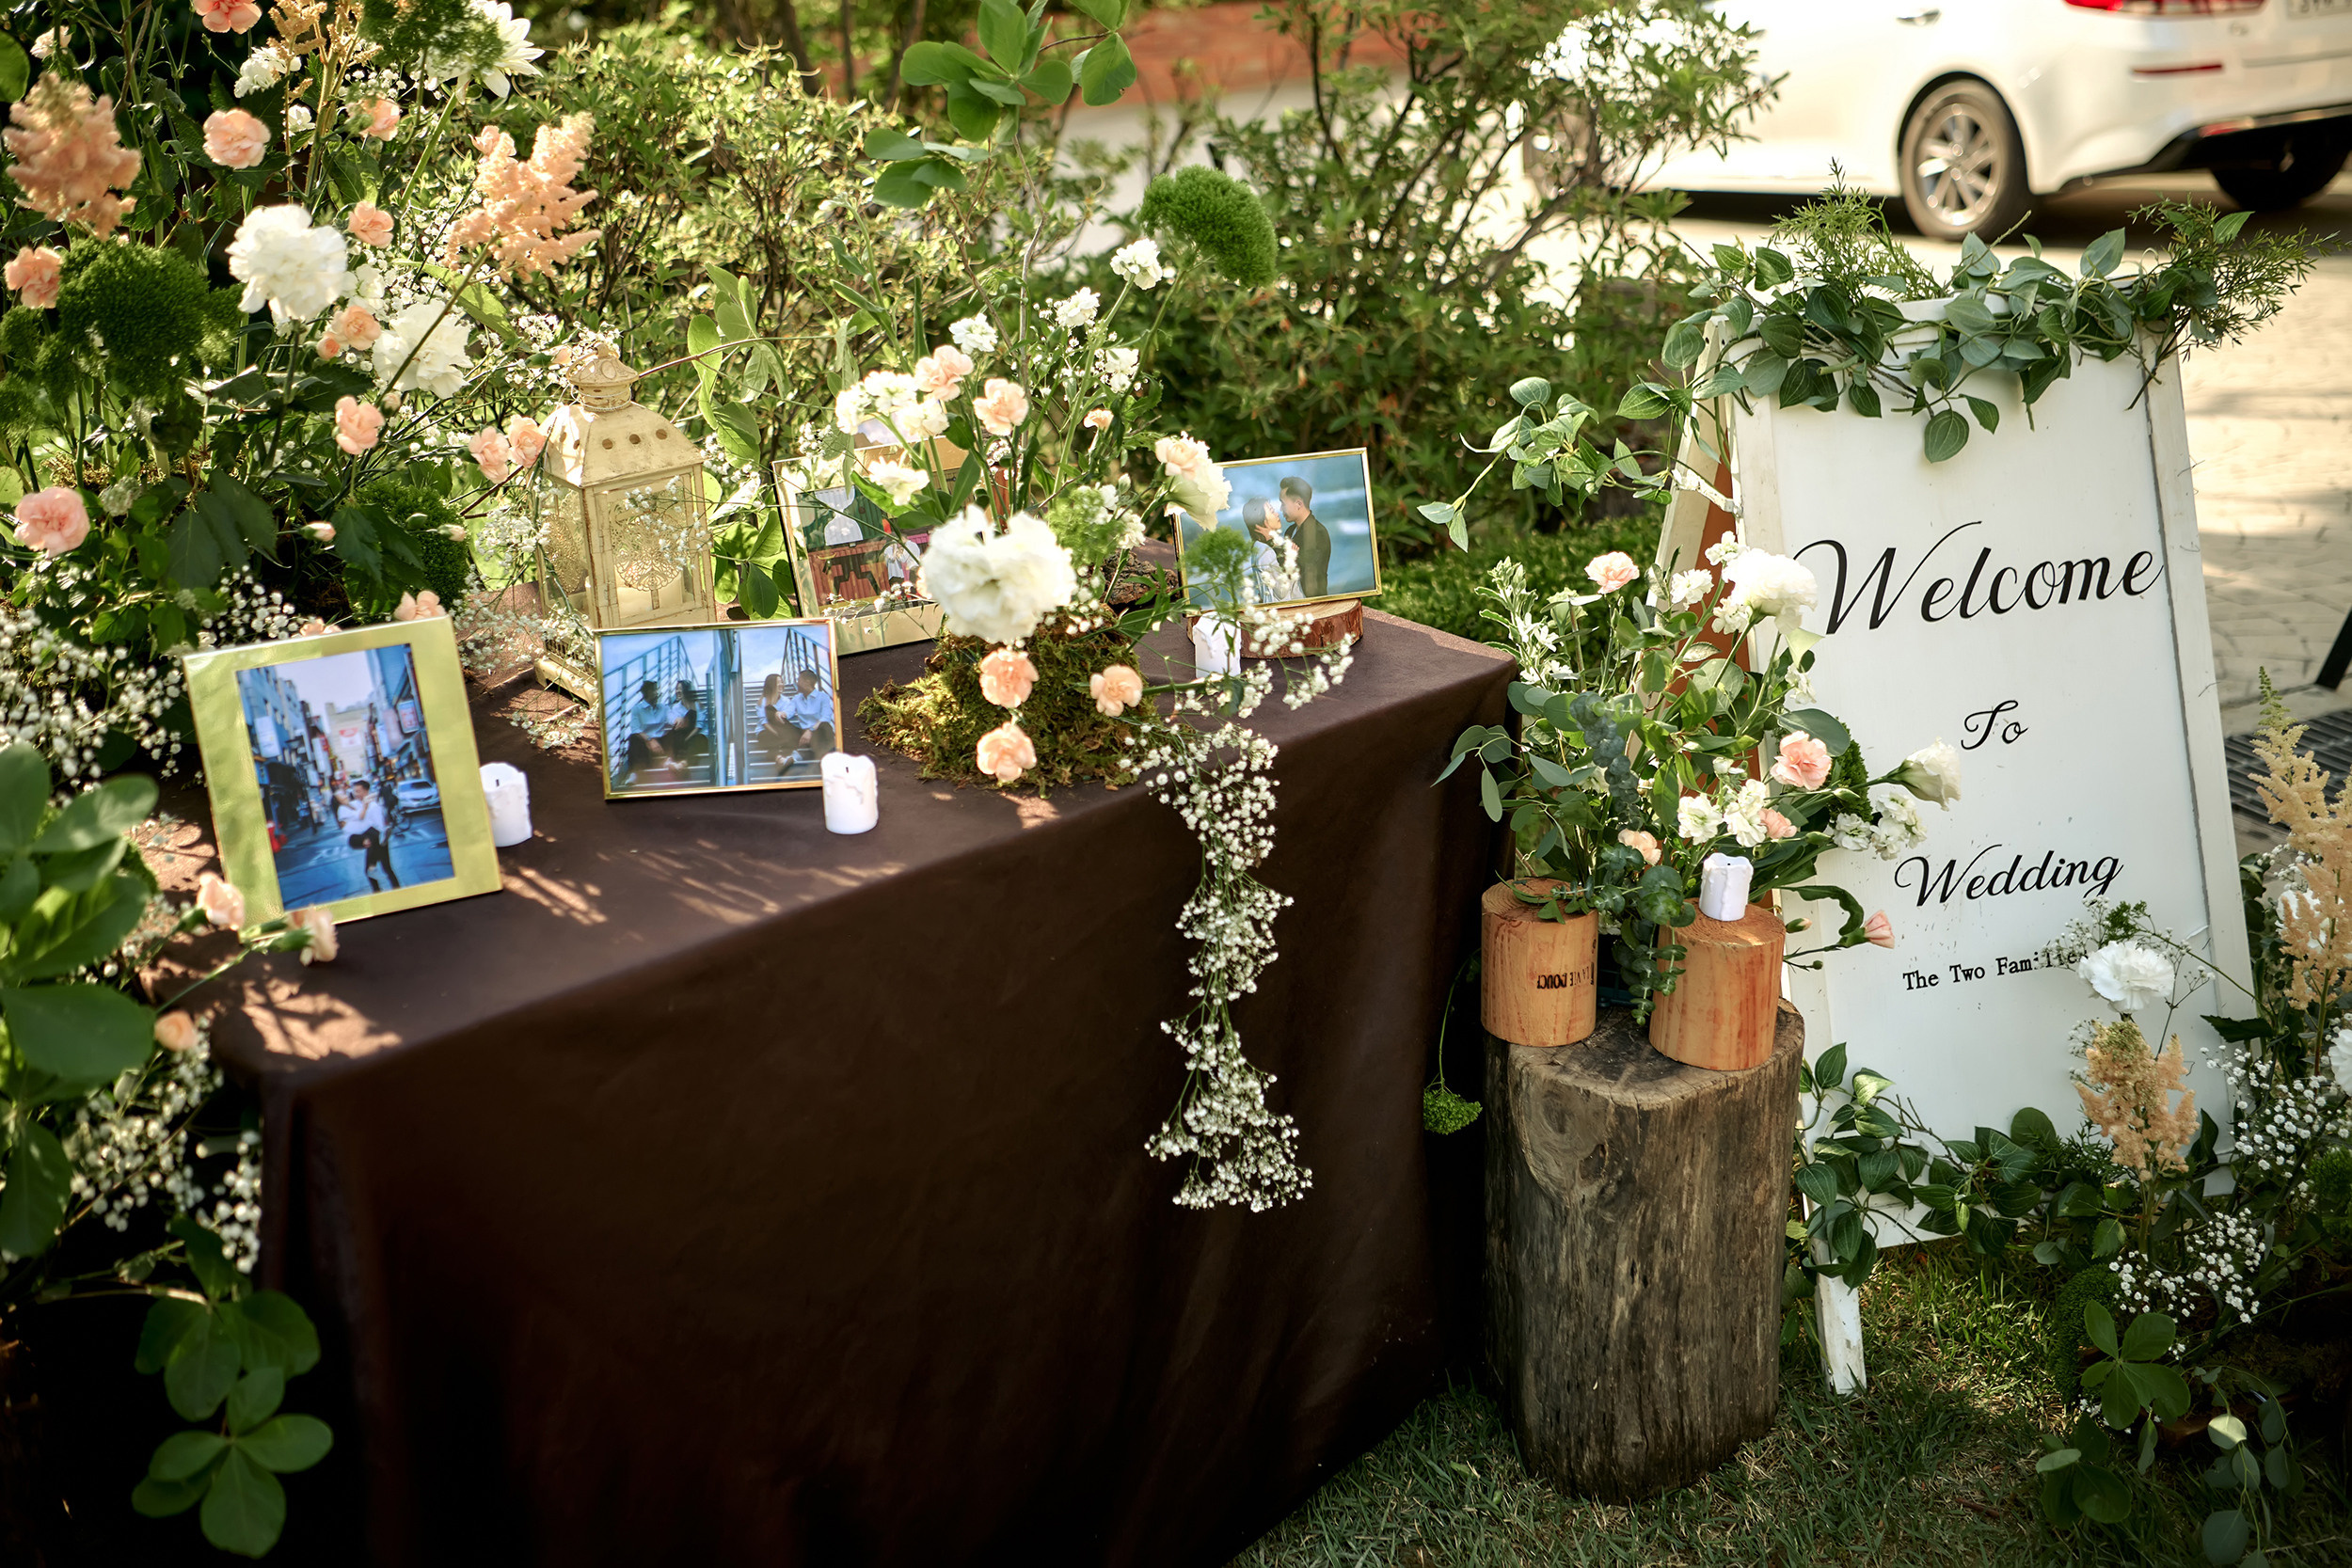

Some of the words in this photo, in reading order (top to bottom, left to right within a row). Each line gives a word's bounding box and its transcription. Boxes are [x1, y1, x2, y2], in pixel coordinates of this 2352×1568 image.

[1792, 520, 2164, 635] Welcome
[1961, 700, 2028, 751] To
[1894, 845, 2123, 907] Wedding
[1903, 972, 1940, 990] The
[1949, 963, 1985, 983] Two
[1995, 950, 2089, 975] Familie
